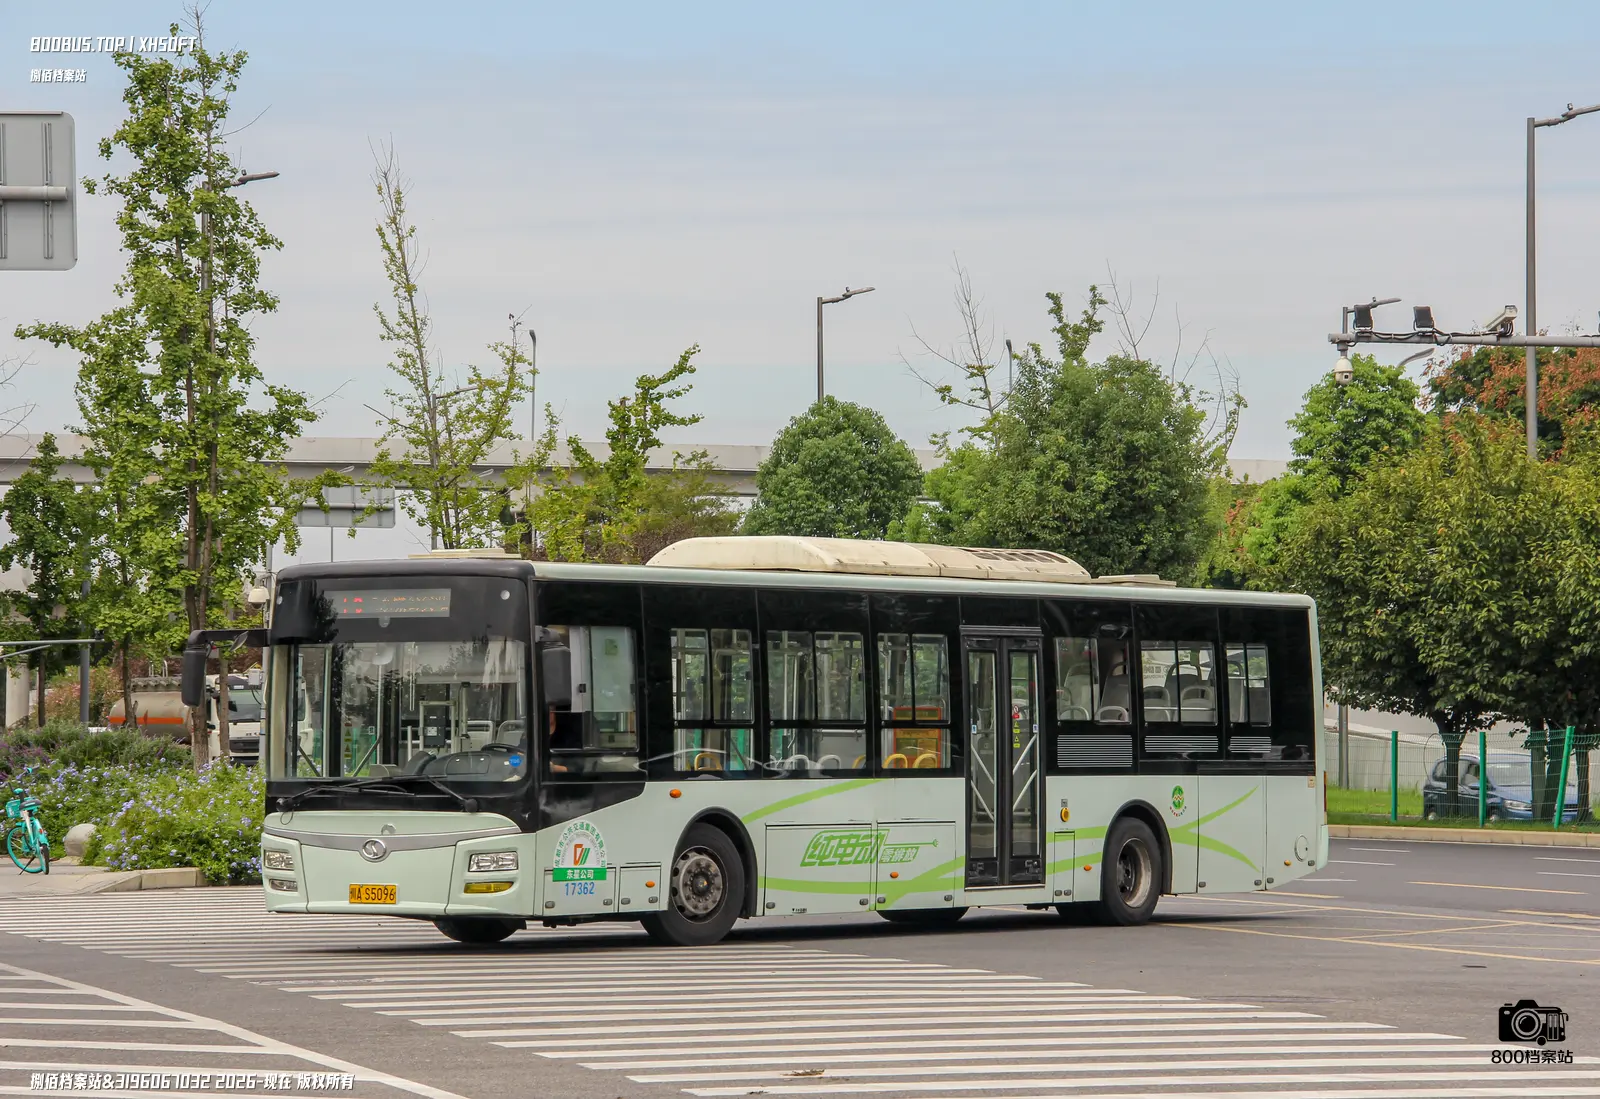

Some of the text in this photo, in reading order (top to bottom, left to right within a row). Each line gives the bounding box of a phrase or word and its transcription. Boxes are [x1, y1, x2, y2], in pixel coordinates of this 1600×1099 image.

[800, 830, 887, 868] 纯电动
[564, 881, 595, 896] 17362
